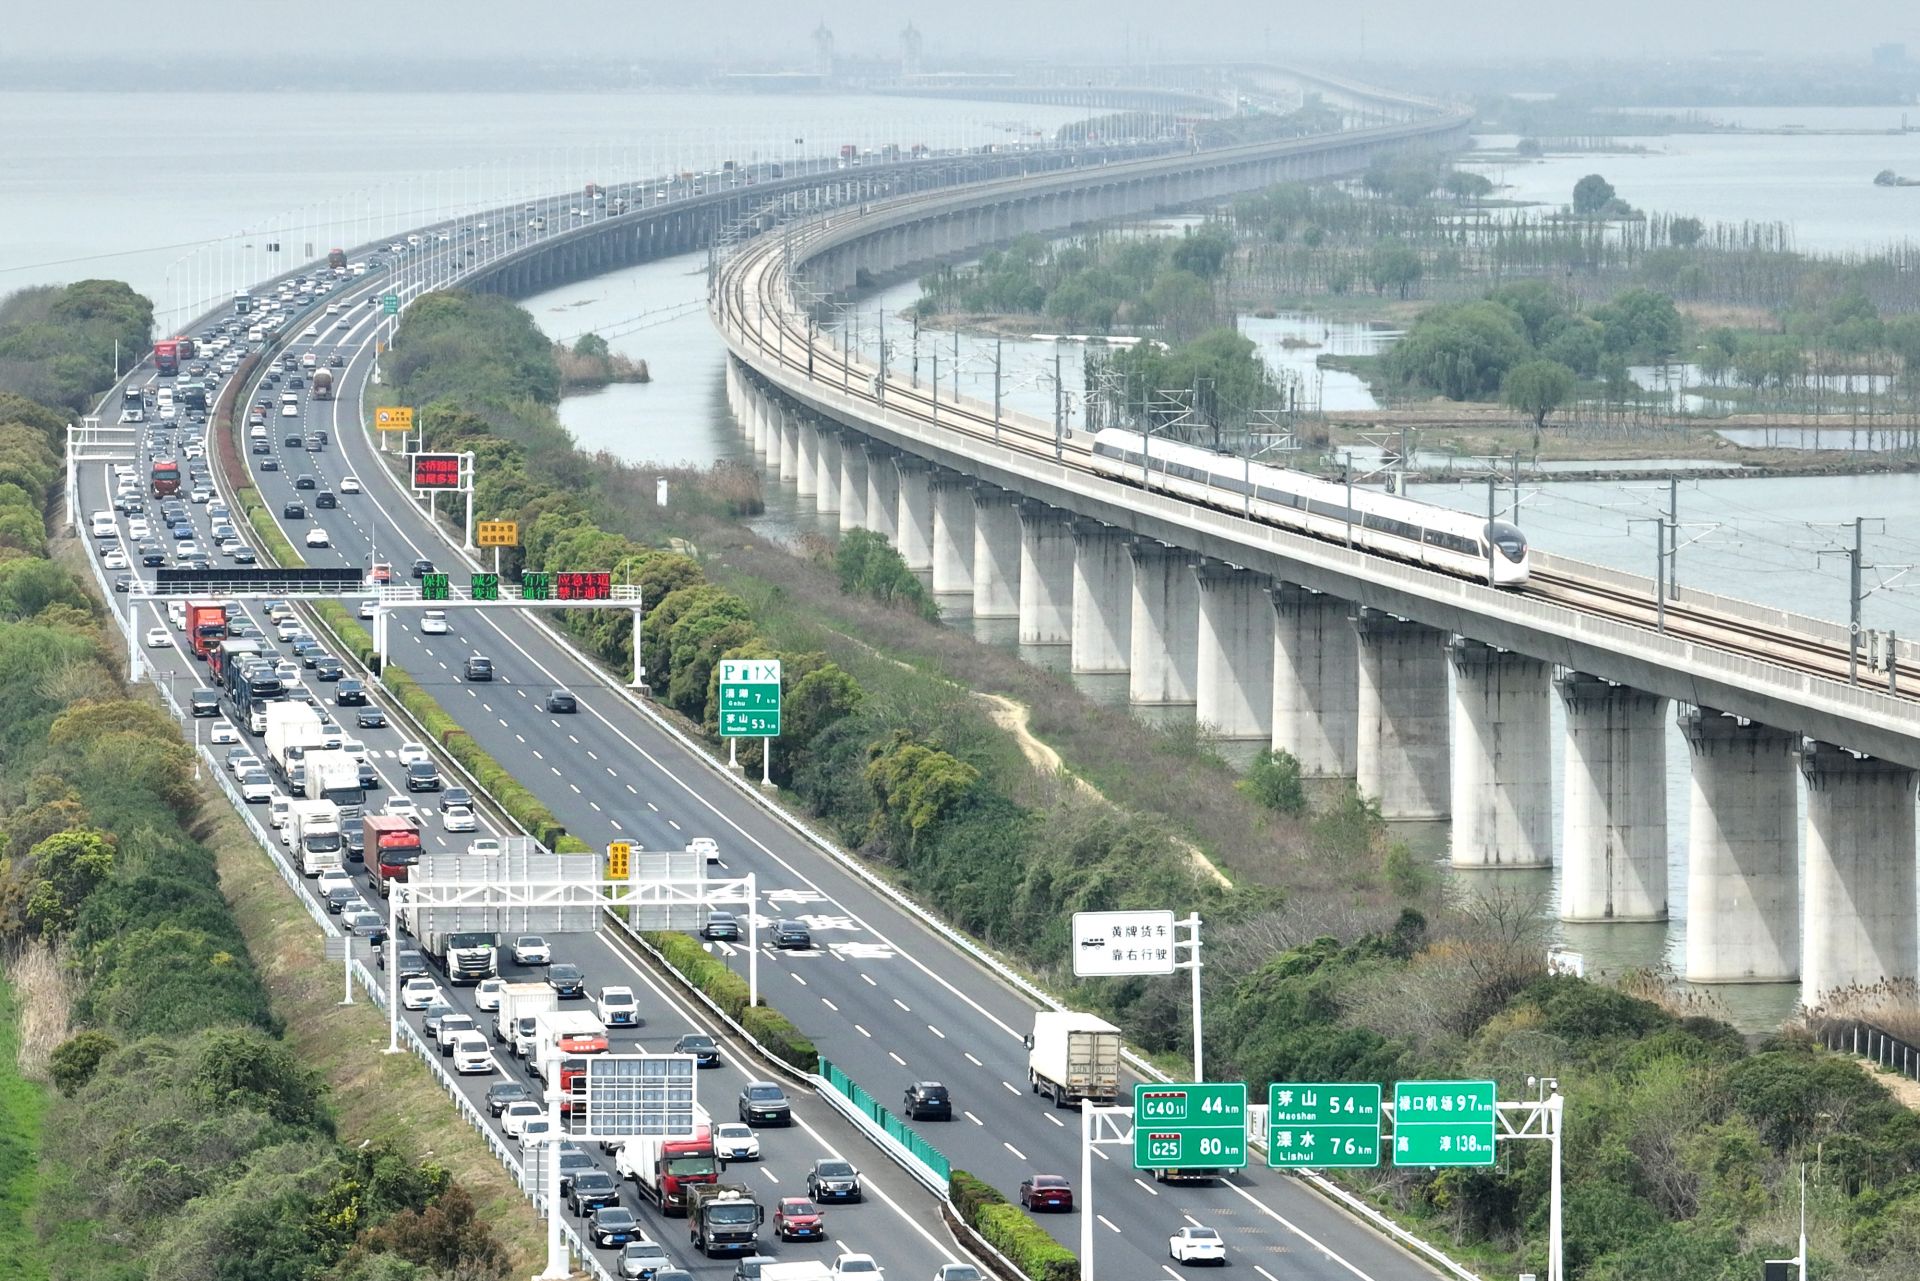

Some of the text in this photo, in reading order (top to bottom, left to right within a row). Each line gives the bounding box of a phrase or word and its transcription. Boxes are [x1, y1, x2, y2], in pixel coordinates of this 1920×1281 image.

[415, 460, 458, 471] 大桥路段
[423, 574, 447, 587] 保持
[472, 574, 498, 587] 减少
[523, 573, 548, 586] 有序
[558, 573, 610, 586] 应急车道
[423, 587, 448, 600] 车距
[472, 587, 497, 600] 变道
[523, 587, 547, 600] 通行
[558, 587, 609, 600] 禁止通行
[754, 694, 761, 704] 7
[726, 713, 748, 724] 茅山
[751, 719, 765, 729] 53
[1111, 925, 1167, 938] 黄牌货车
[1112, 949, 1168, 961] 靠右行驶
[1146, 1096, 1239, 1115] G4011 44 km
[1277, 1089, 1373, 1114] 茅山 54 km
[1456, 1094, 1478, 1112] 97
[1477, 1103, 1492, 1111] km
[1278, 1111, 1317, 1120] Maoshan
[1152, 1137, 1239, 1156] G25 80 km
[1276, 1131, 1372, 1155] 溧水 76 km
[1456, 1134, 1477, 1152] 138
[1279, 1151, 1314, 1161] Lishui
